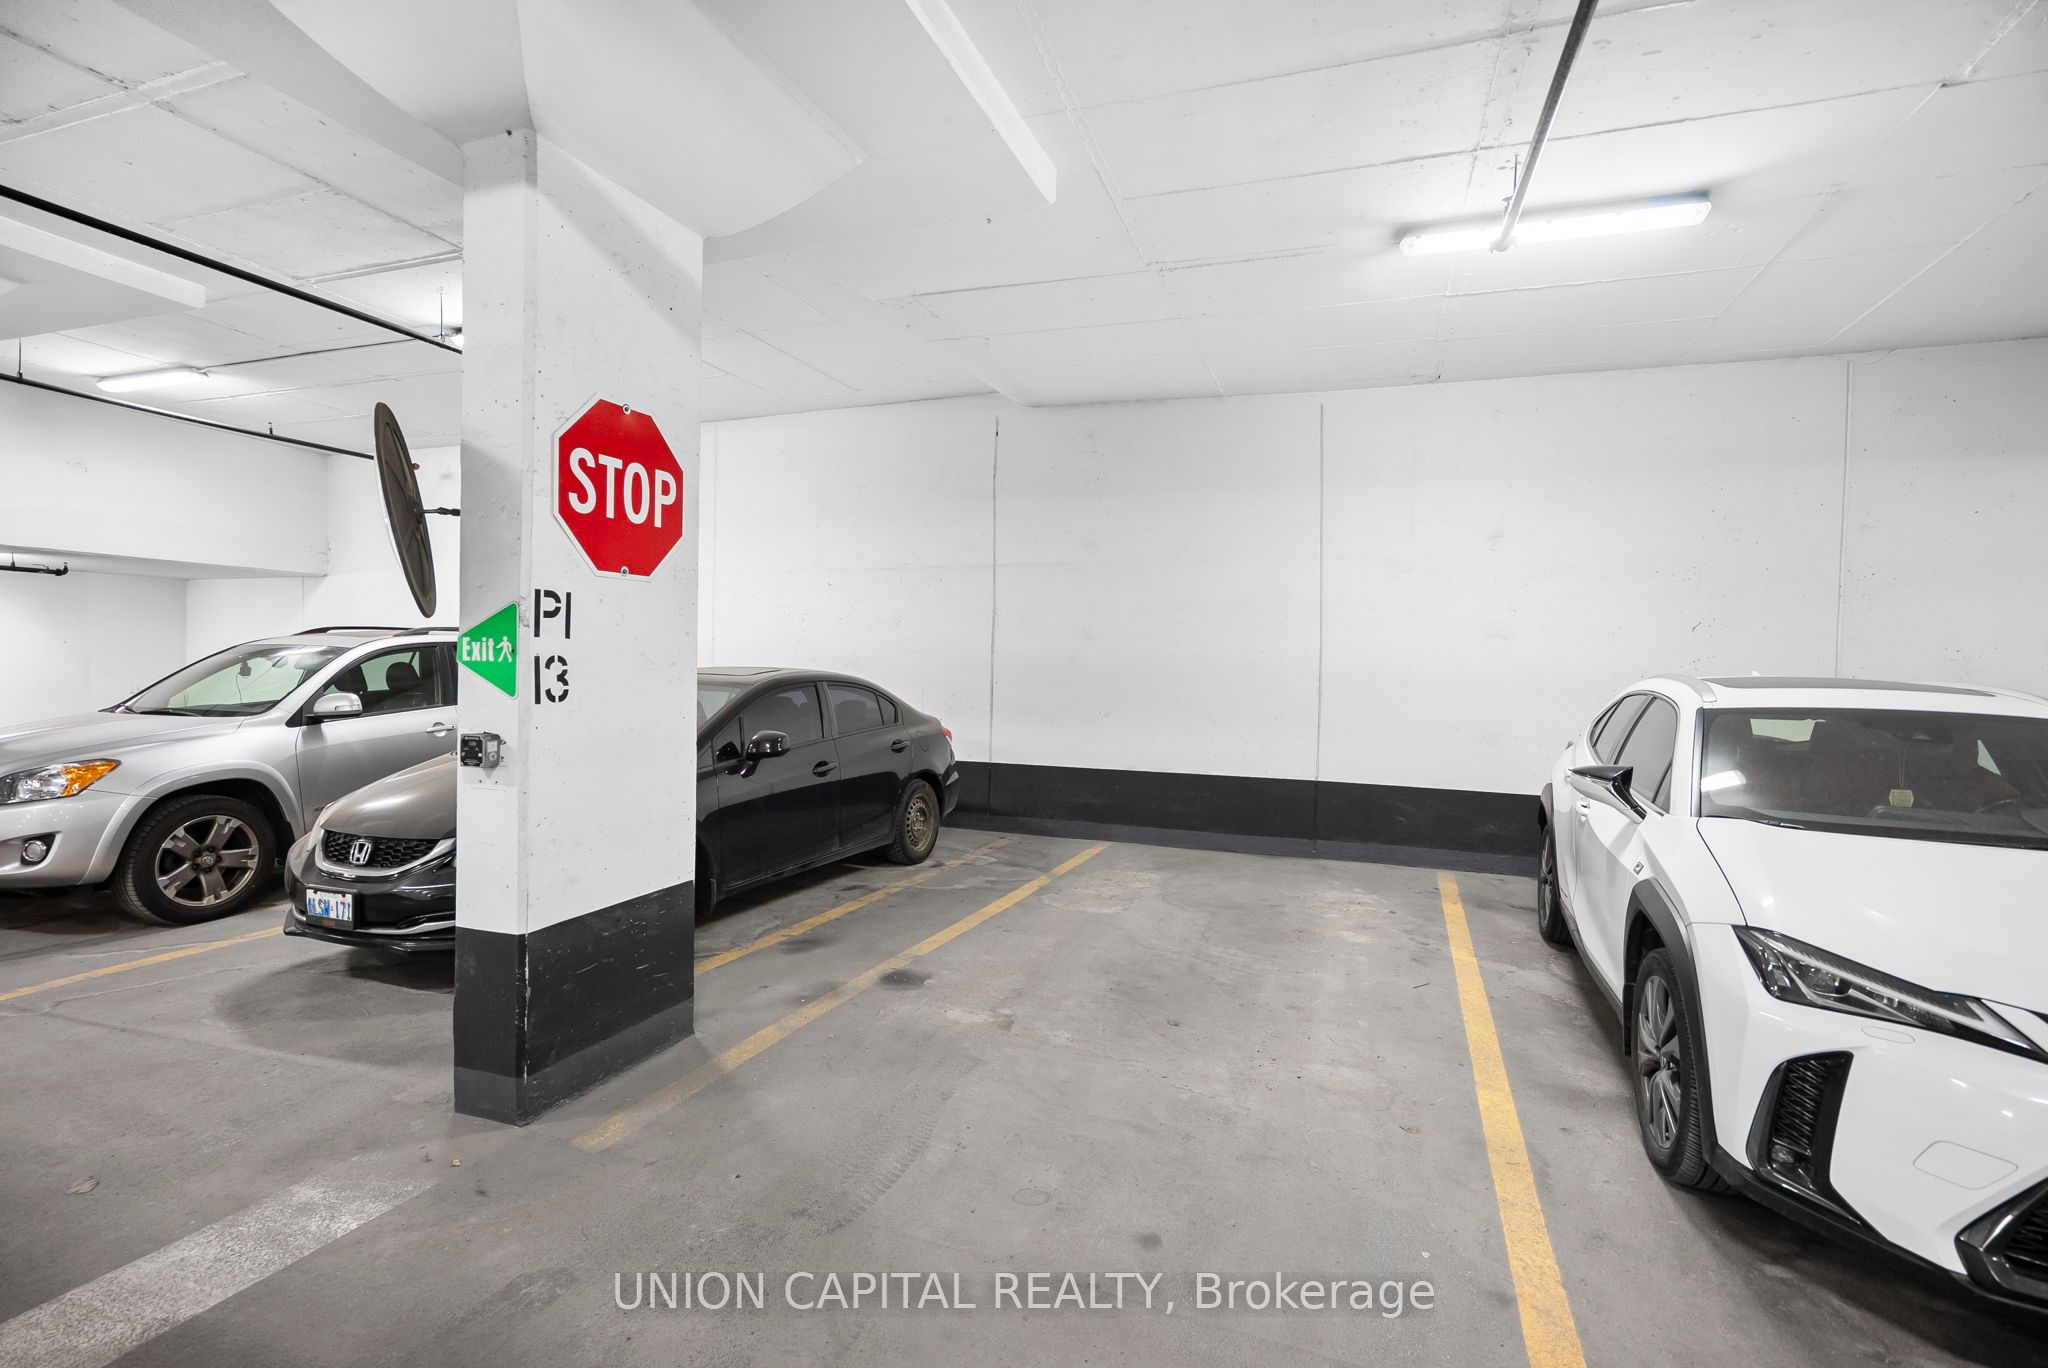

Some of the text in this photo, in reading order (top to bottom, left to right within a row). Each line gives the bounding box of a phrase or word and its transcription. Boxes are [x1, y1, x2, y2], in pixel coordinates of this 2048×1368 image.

[568, 447, 677, 528] STOP
[462, 637, 494, 662] Exit
[534, 655, 569, 705] 13
